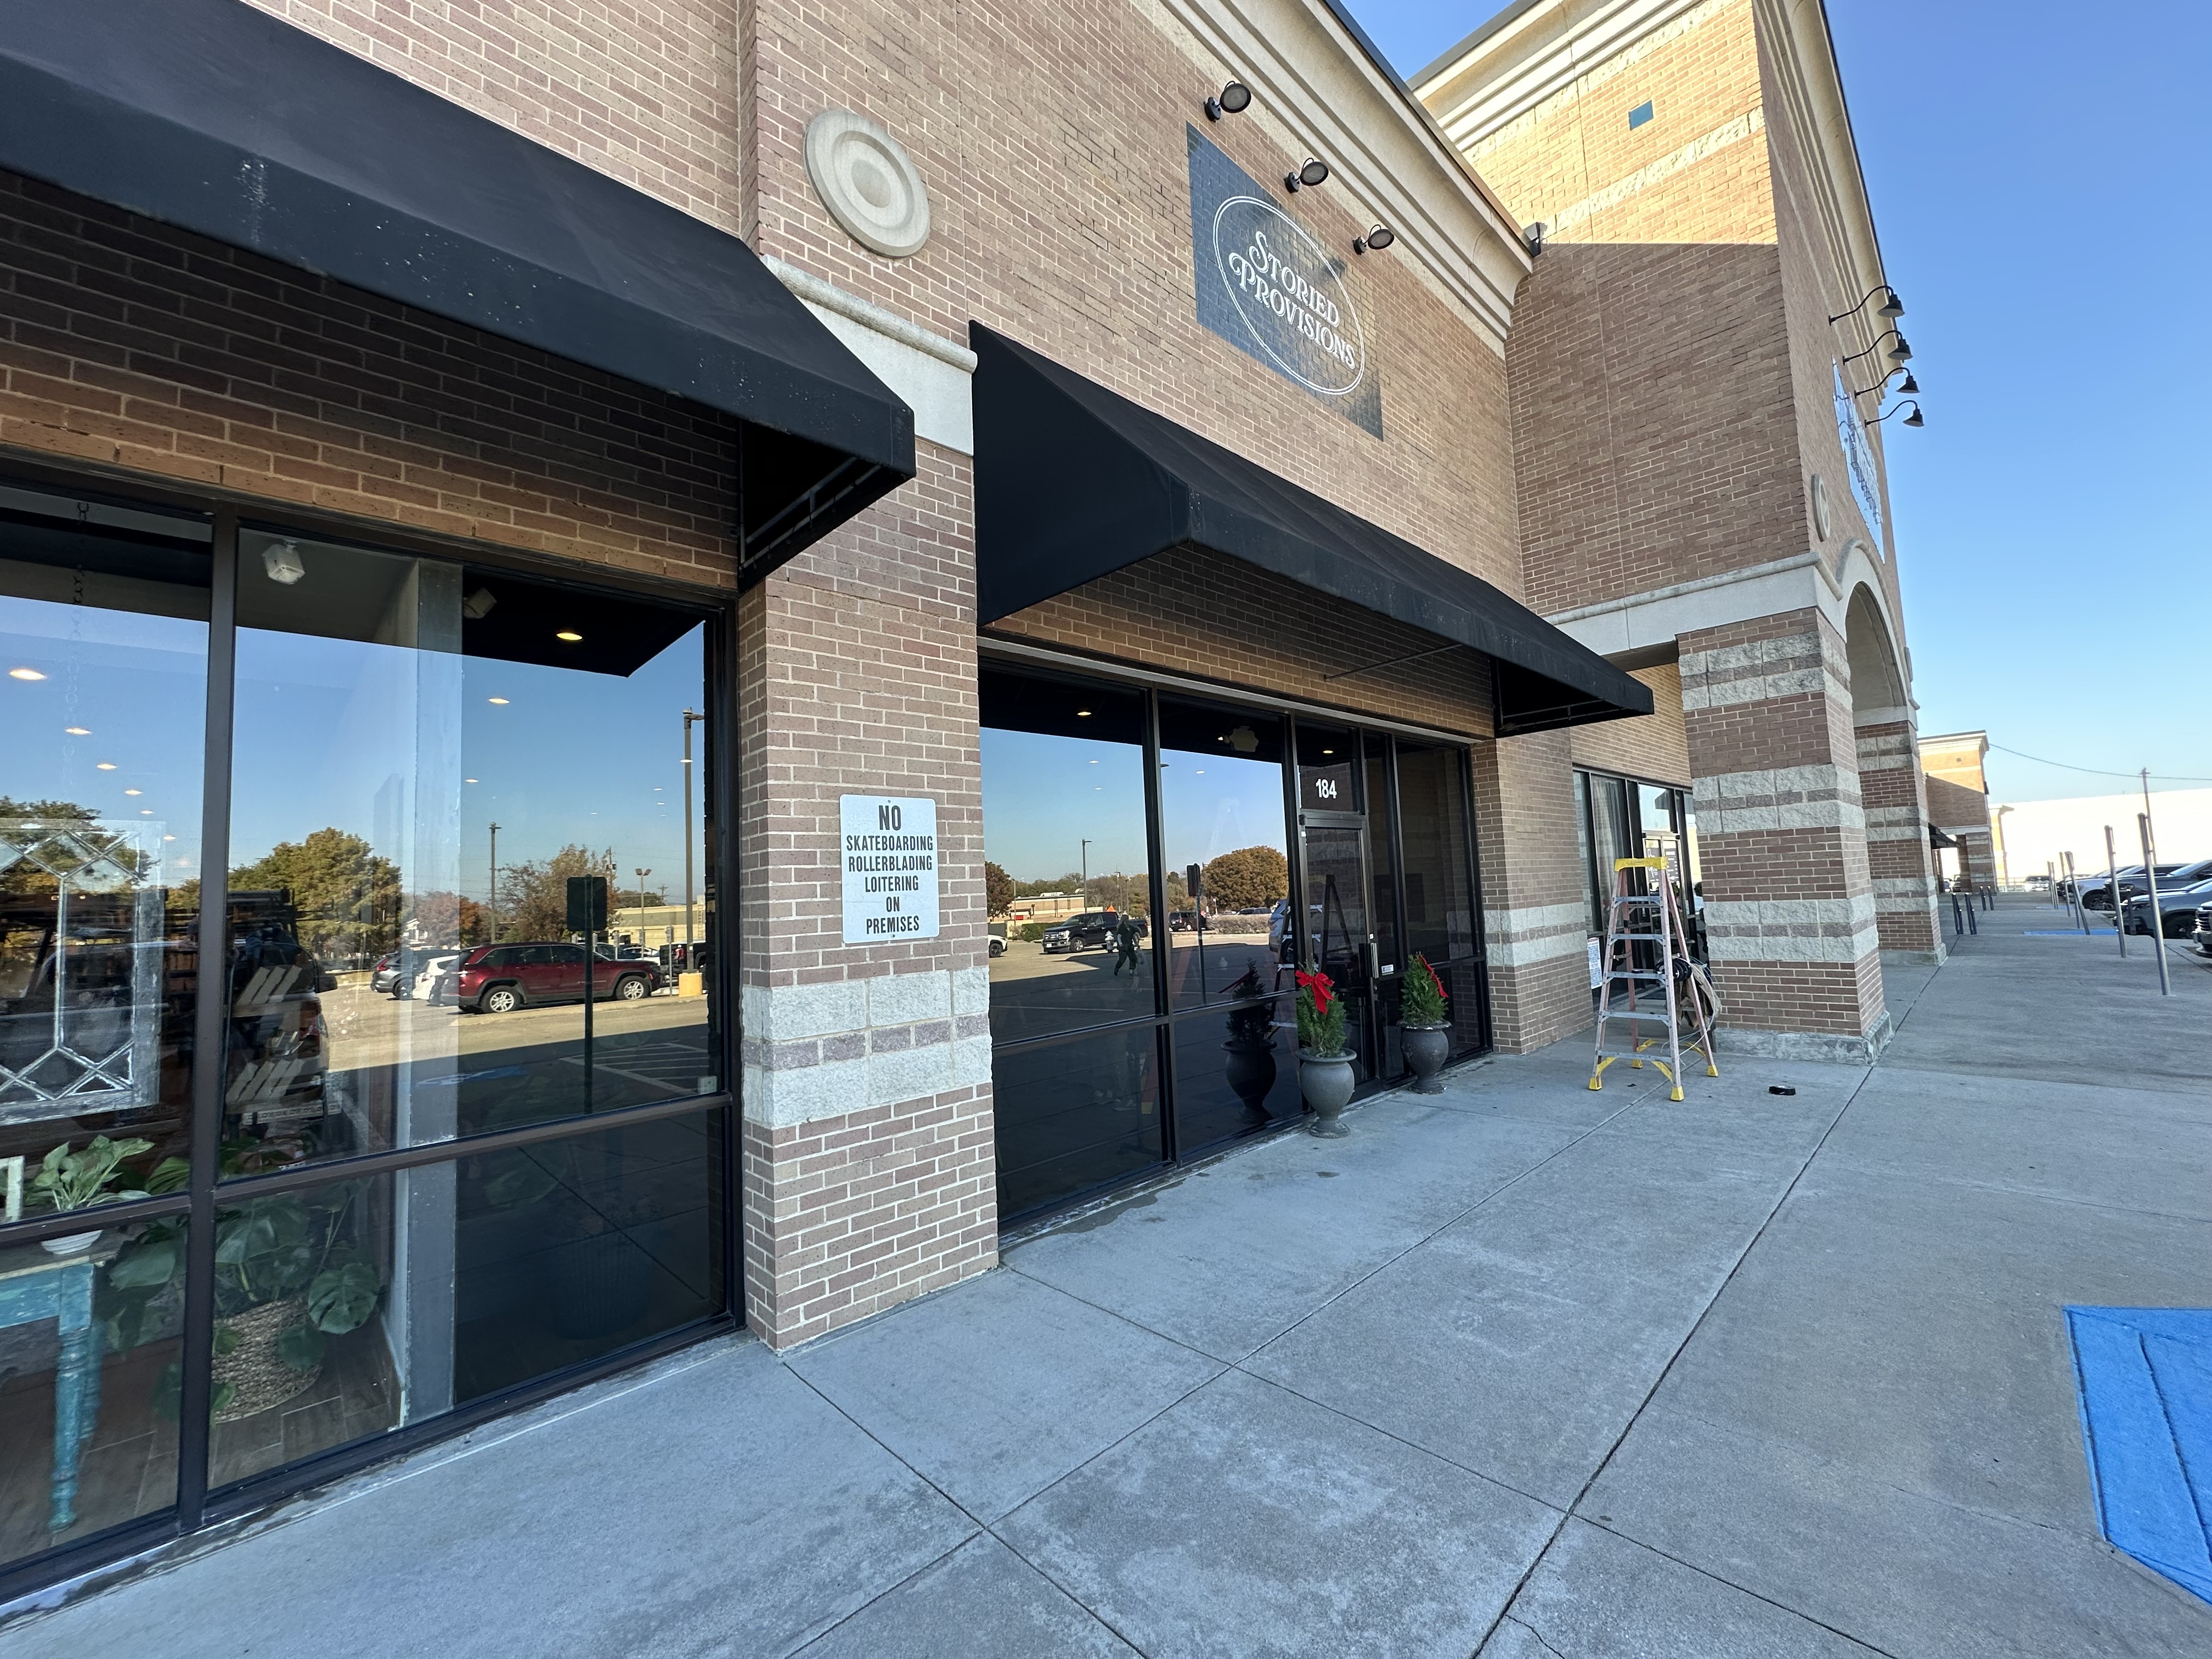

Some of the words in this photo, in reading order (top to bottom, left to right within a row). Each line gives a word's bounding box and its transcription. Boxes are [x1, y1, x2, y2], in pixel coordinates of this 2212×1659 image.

[1249, 231, 1340, 328] STORIED
[1229, 252, 1355, 370] PROVISIONS
[1316, 778, 1337, 799] 184
[878, 805, 901, 831] NO
[846, 835, 933, 851] SKATEBOARDING
[849, 855, 933, 872] ROLLERBLADING
[865, 875, 919, 893] LOITERING
[886, 896, 900, 912] ON
[866, 915, 919, 934] PREMISES
